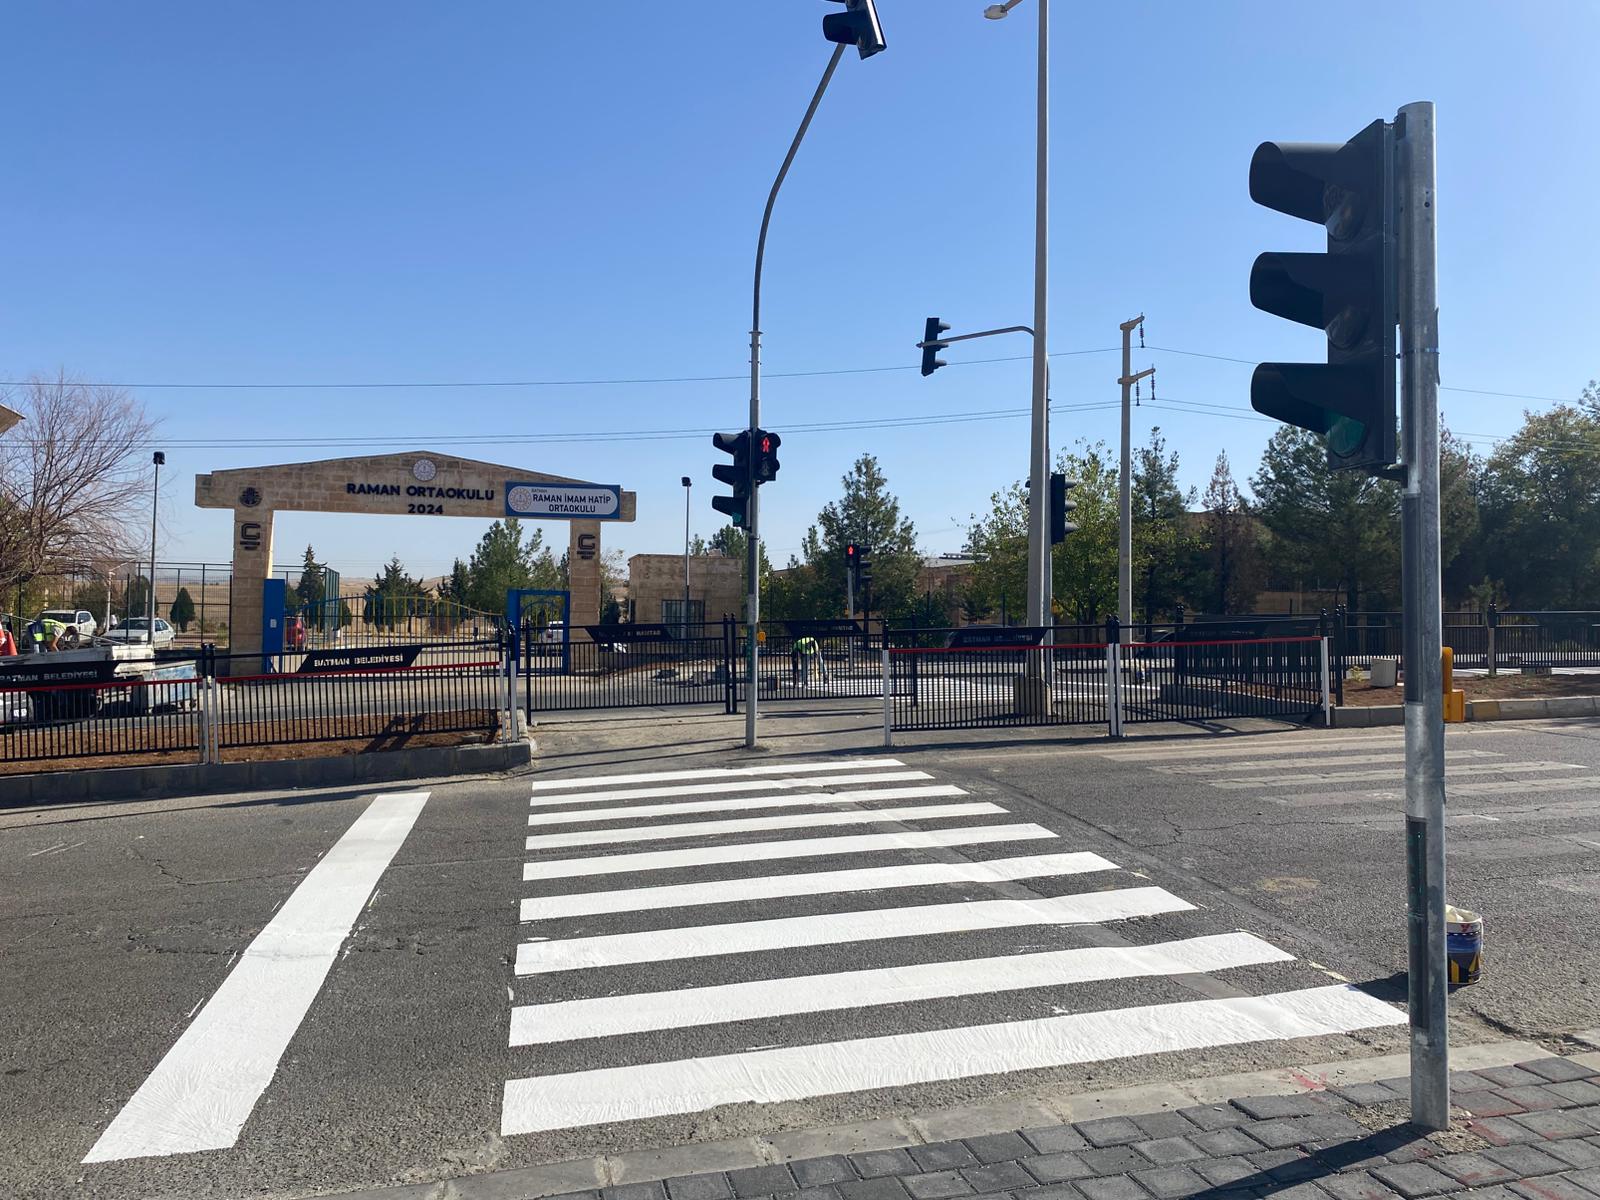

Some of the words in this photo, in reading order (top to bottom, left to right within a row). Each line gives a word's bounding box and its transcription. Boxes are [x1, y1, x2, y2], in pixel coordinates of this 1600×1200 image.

[346, 483, 401, 496] RAMAN
[406, 485, 495, 500] ORTAOKULU
[533, 493, 562, 502] RAMAN
[564, 493, 587, 503] İMAM
[588, 493, 611, 504] HATİP
[407, 503, 444, 515] 2024
[548, 504, 596, 513] ORTAOKULU
[314, 658, 350, 667] BATMAN
[354, 653, 404, 665] BELEDİYESİ
[43, 670, 98, 680] BELEDİYESİ
